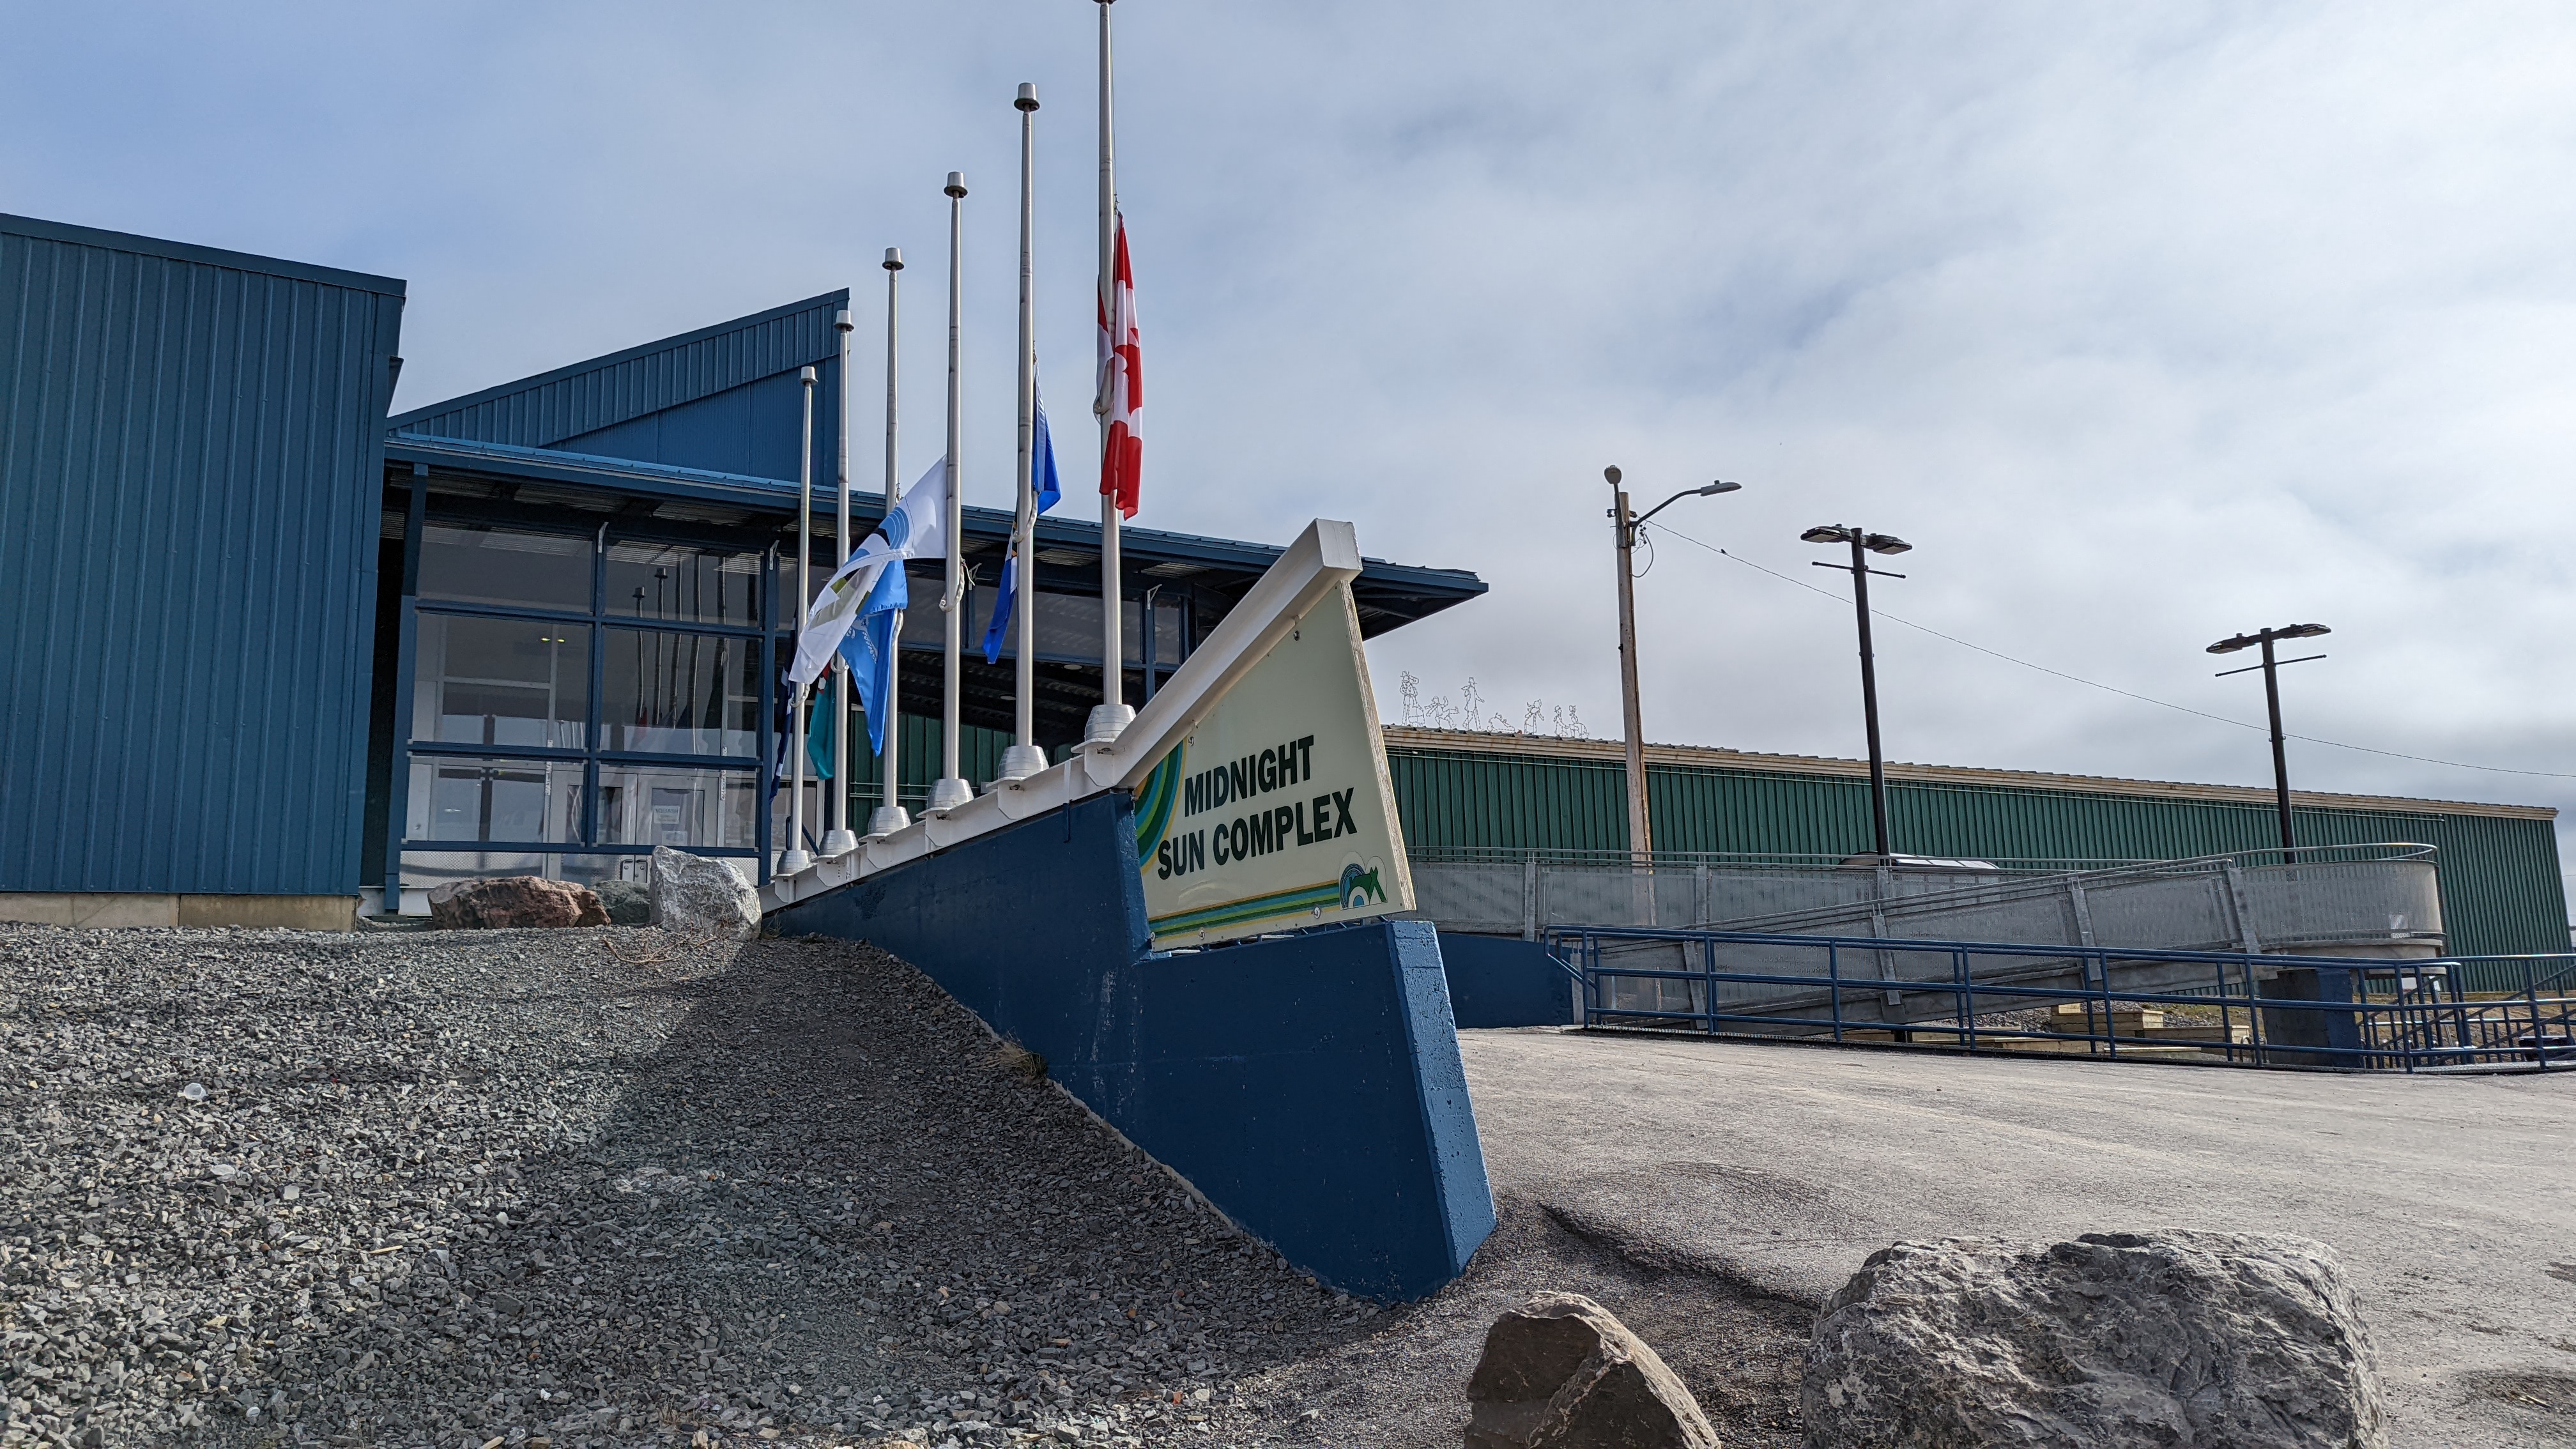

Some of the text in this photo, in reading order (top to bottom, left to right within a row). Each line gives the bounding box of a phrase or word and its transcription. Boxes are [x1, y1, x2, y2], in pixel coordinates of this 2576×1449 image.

[1184, 734, 1314, 818] MIDNIGHT
[1157, 786, 1358, 880] SUN COMPLEX
